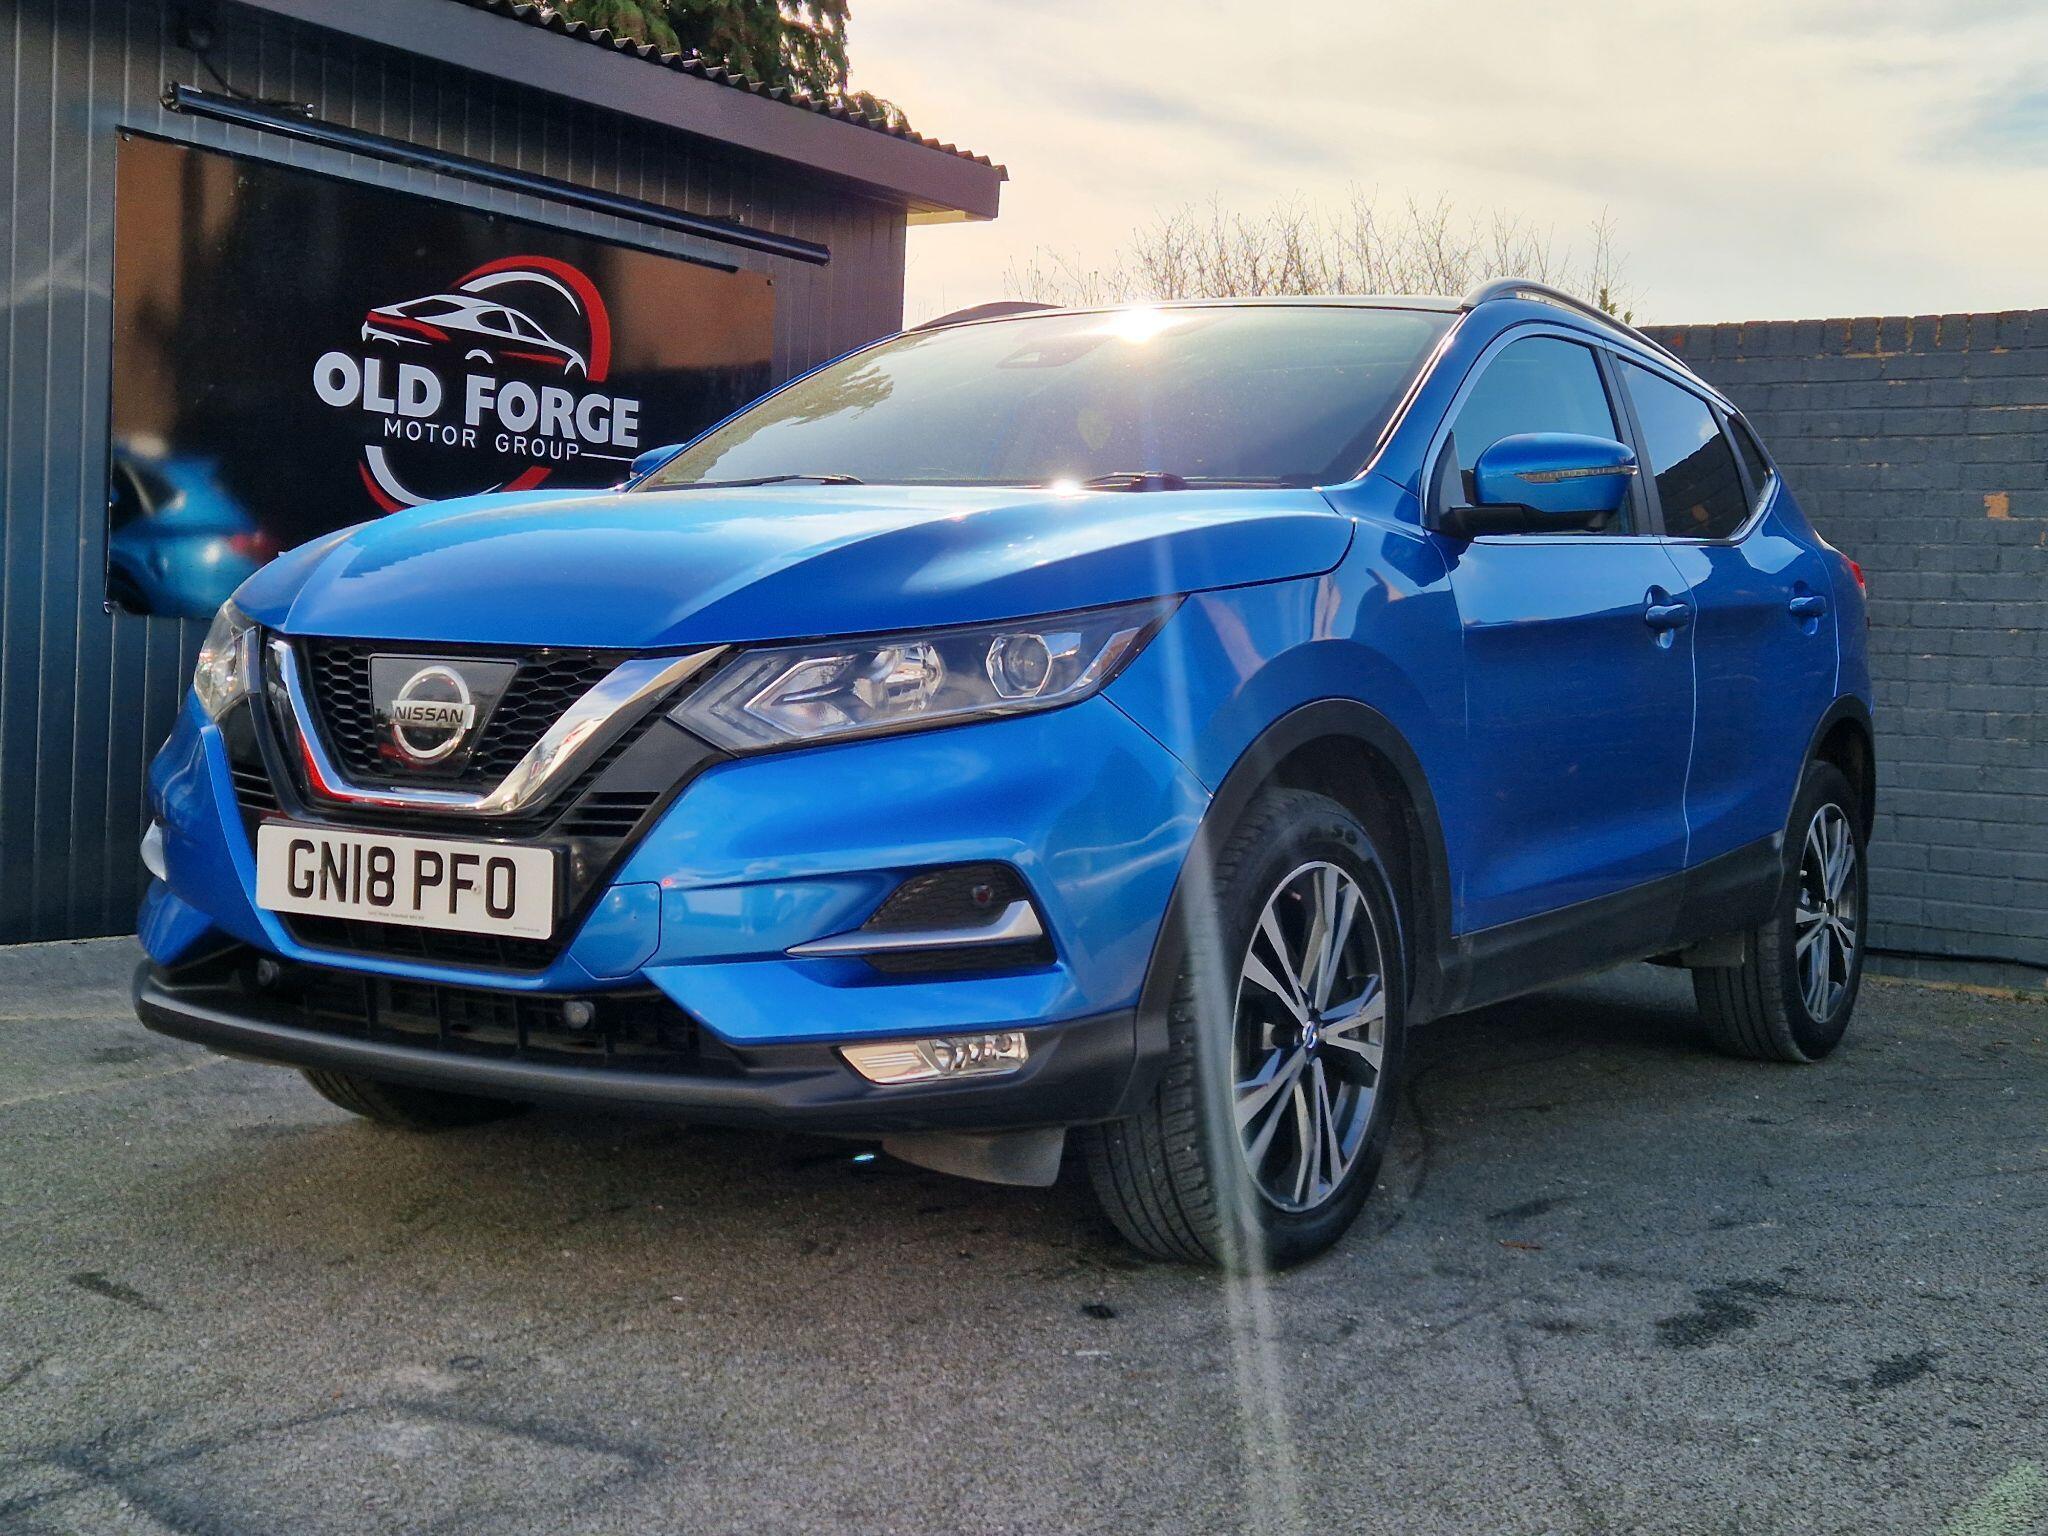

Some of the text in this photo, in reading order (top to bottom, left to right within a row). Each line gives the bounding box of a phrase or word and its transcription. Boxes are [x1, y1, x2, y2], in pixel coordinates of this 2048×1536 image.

[313, 351, 639, 448] OLD FORGE
[384, 418, 580, 461] MOTOR GROUP
[394, 706, 464, 723] NISSAN
[287, 838, 517, 920] GN18 PFO
